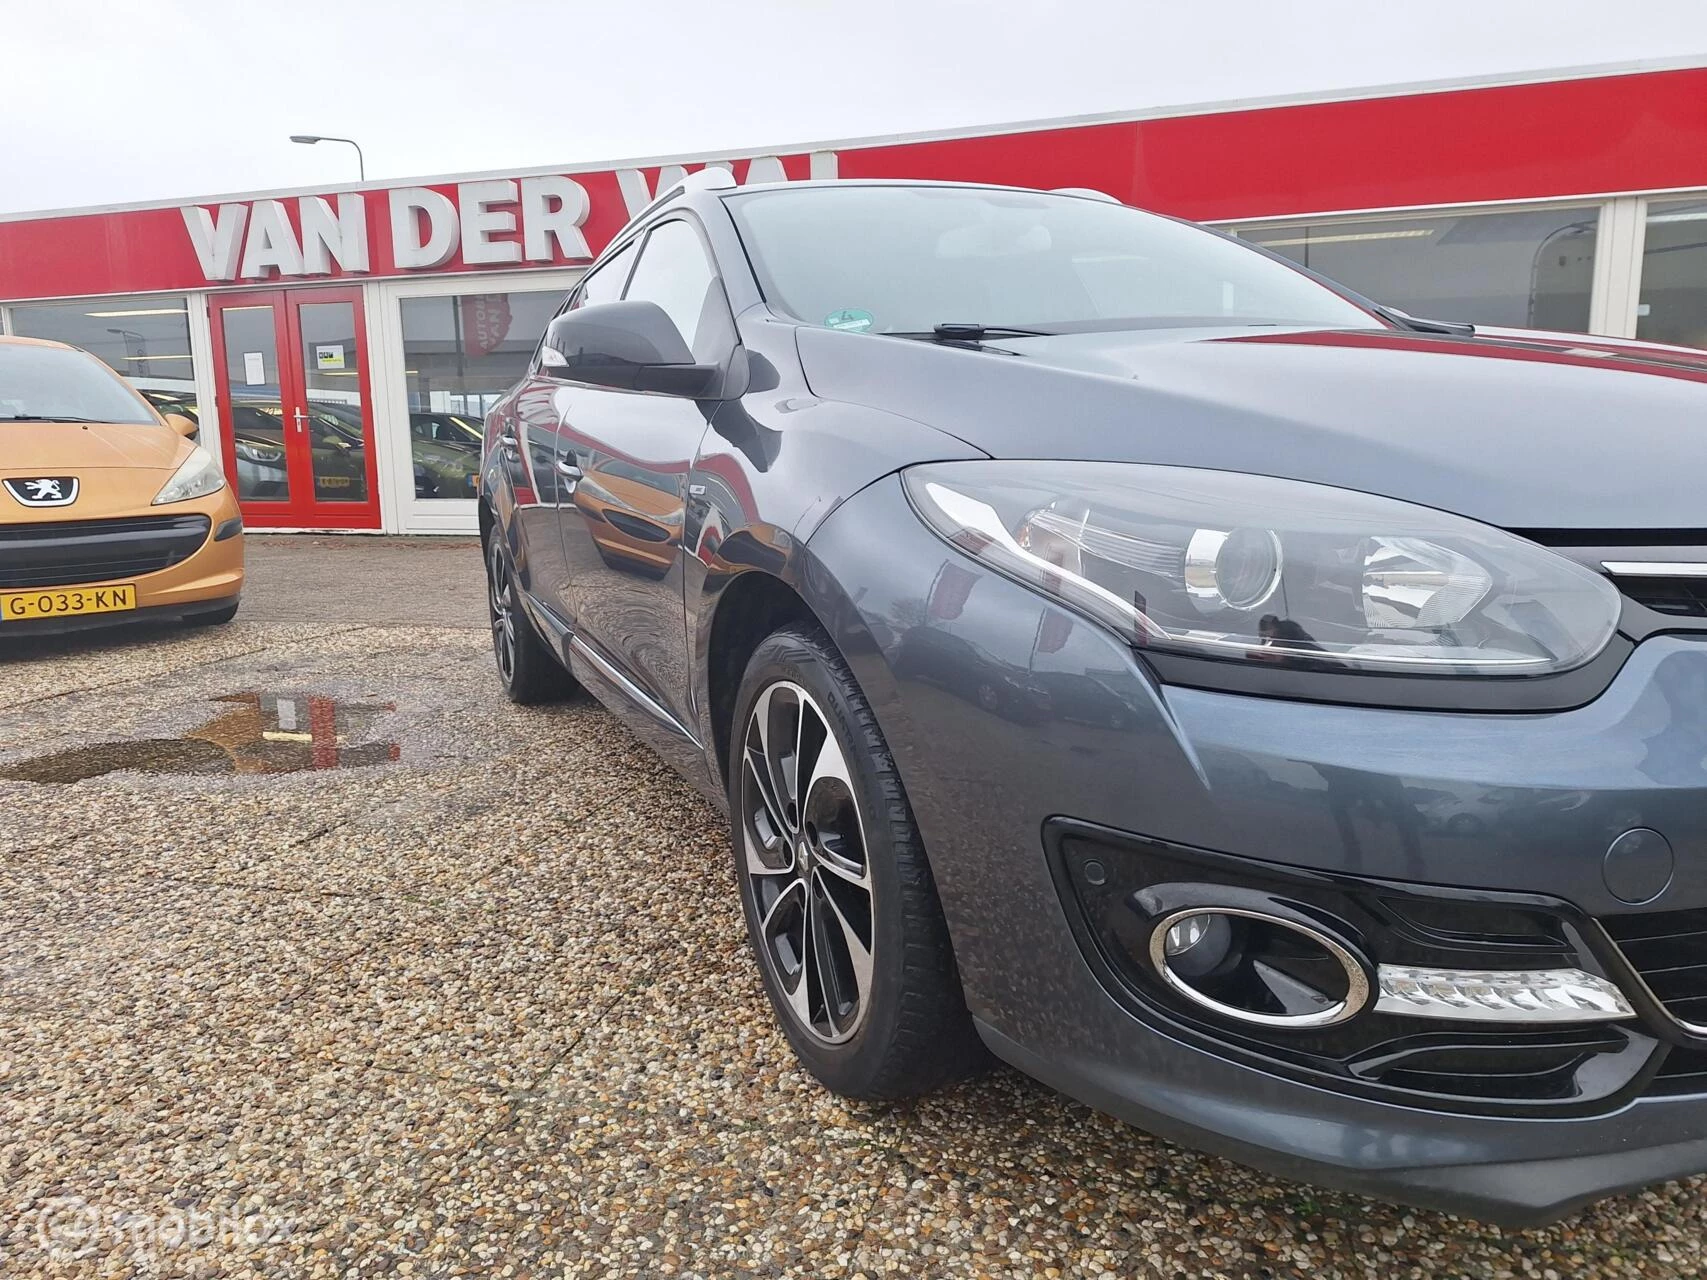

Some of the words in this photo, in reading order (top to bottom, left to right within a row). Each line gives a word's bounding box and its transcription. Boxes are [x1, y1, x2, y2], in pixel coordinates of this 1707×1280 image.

[180, 193, 369, 281] VAN
[389, 175, 593, 269] DER
[10, 589, 127, 615] G-033-KN
